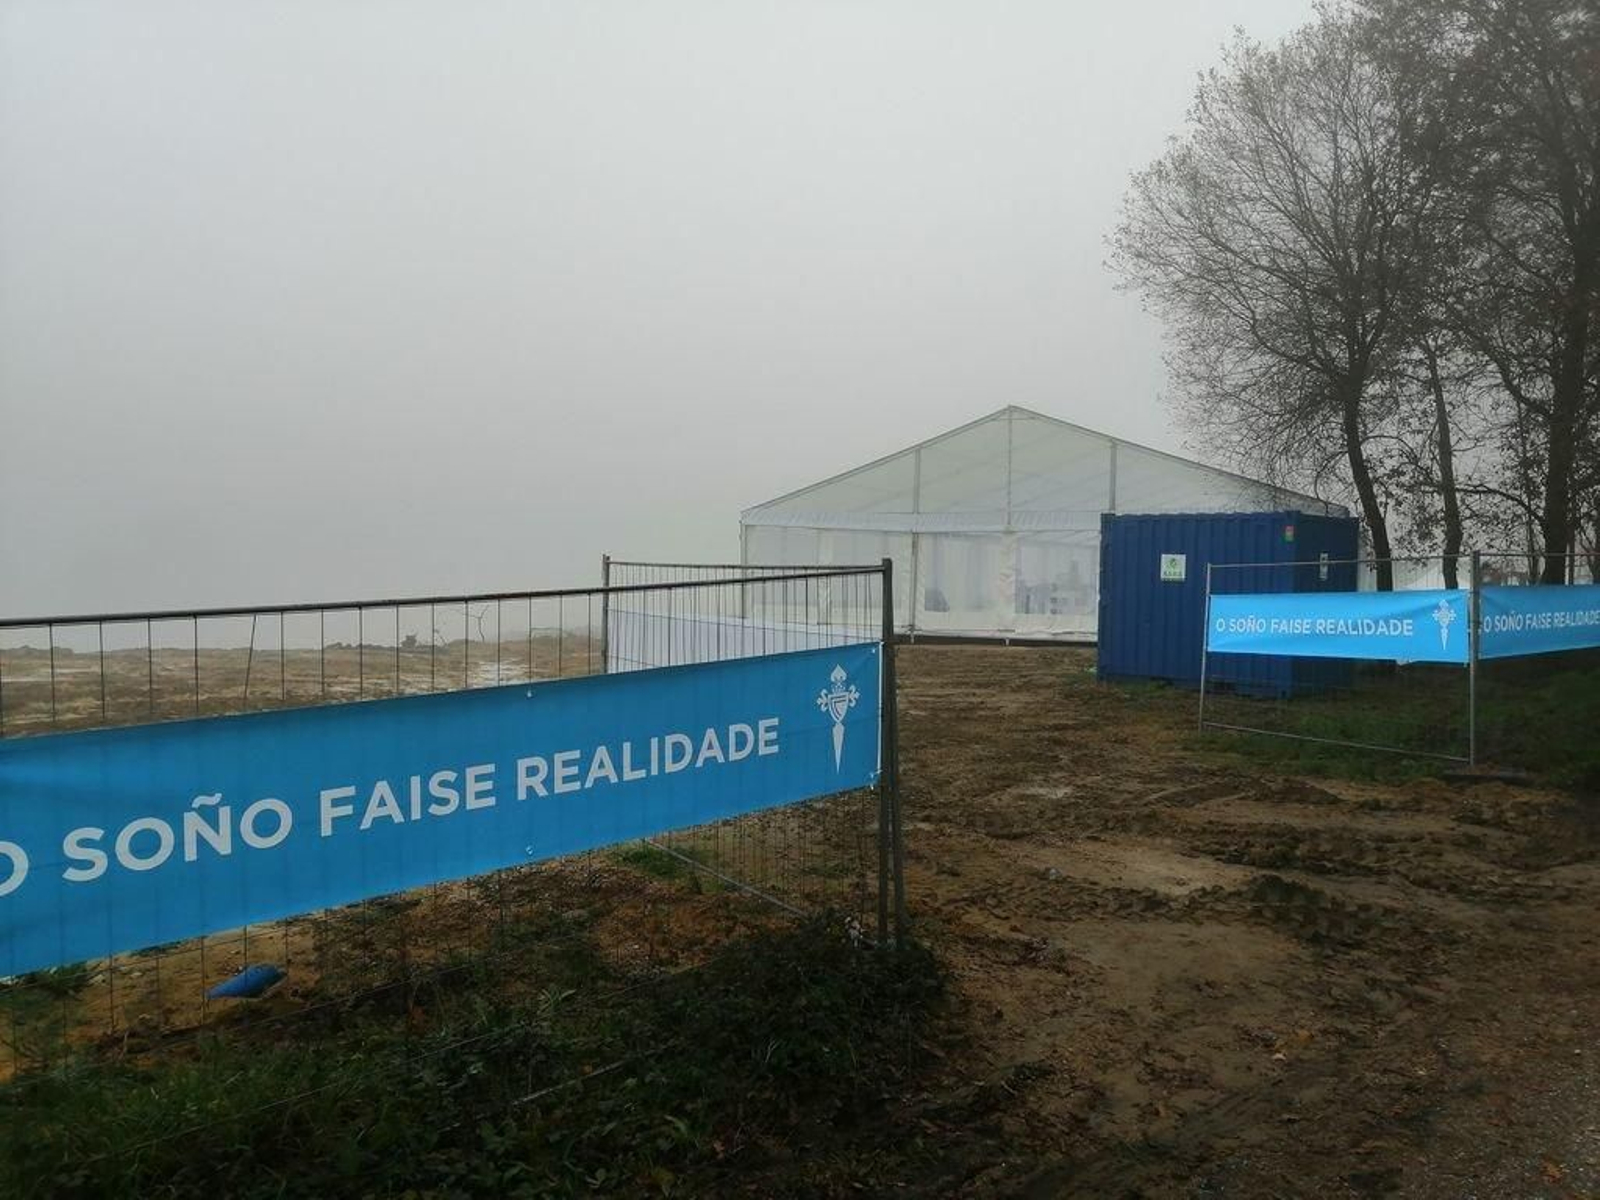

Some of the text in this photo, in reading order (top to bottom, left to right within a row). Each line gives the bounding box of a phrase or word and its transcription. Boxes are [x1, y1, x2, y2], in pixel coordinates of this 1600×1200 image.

[1216, 616, 1413, 635] O SOÑO FAISE REALIDADE
[1484, 616, 1492, 633] O
[1494, 610, 1524, 632] SOÑO
[1526, 613, 1552, 630] FAISE
[62, 792, 293, 882] SOÑO
[320, 763, 496, 837] FAISE
[516, 717, 780, 801] REALIDADE
